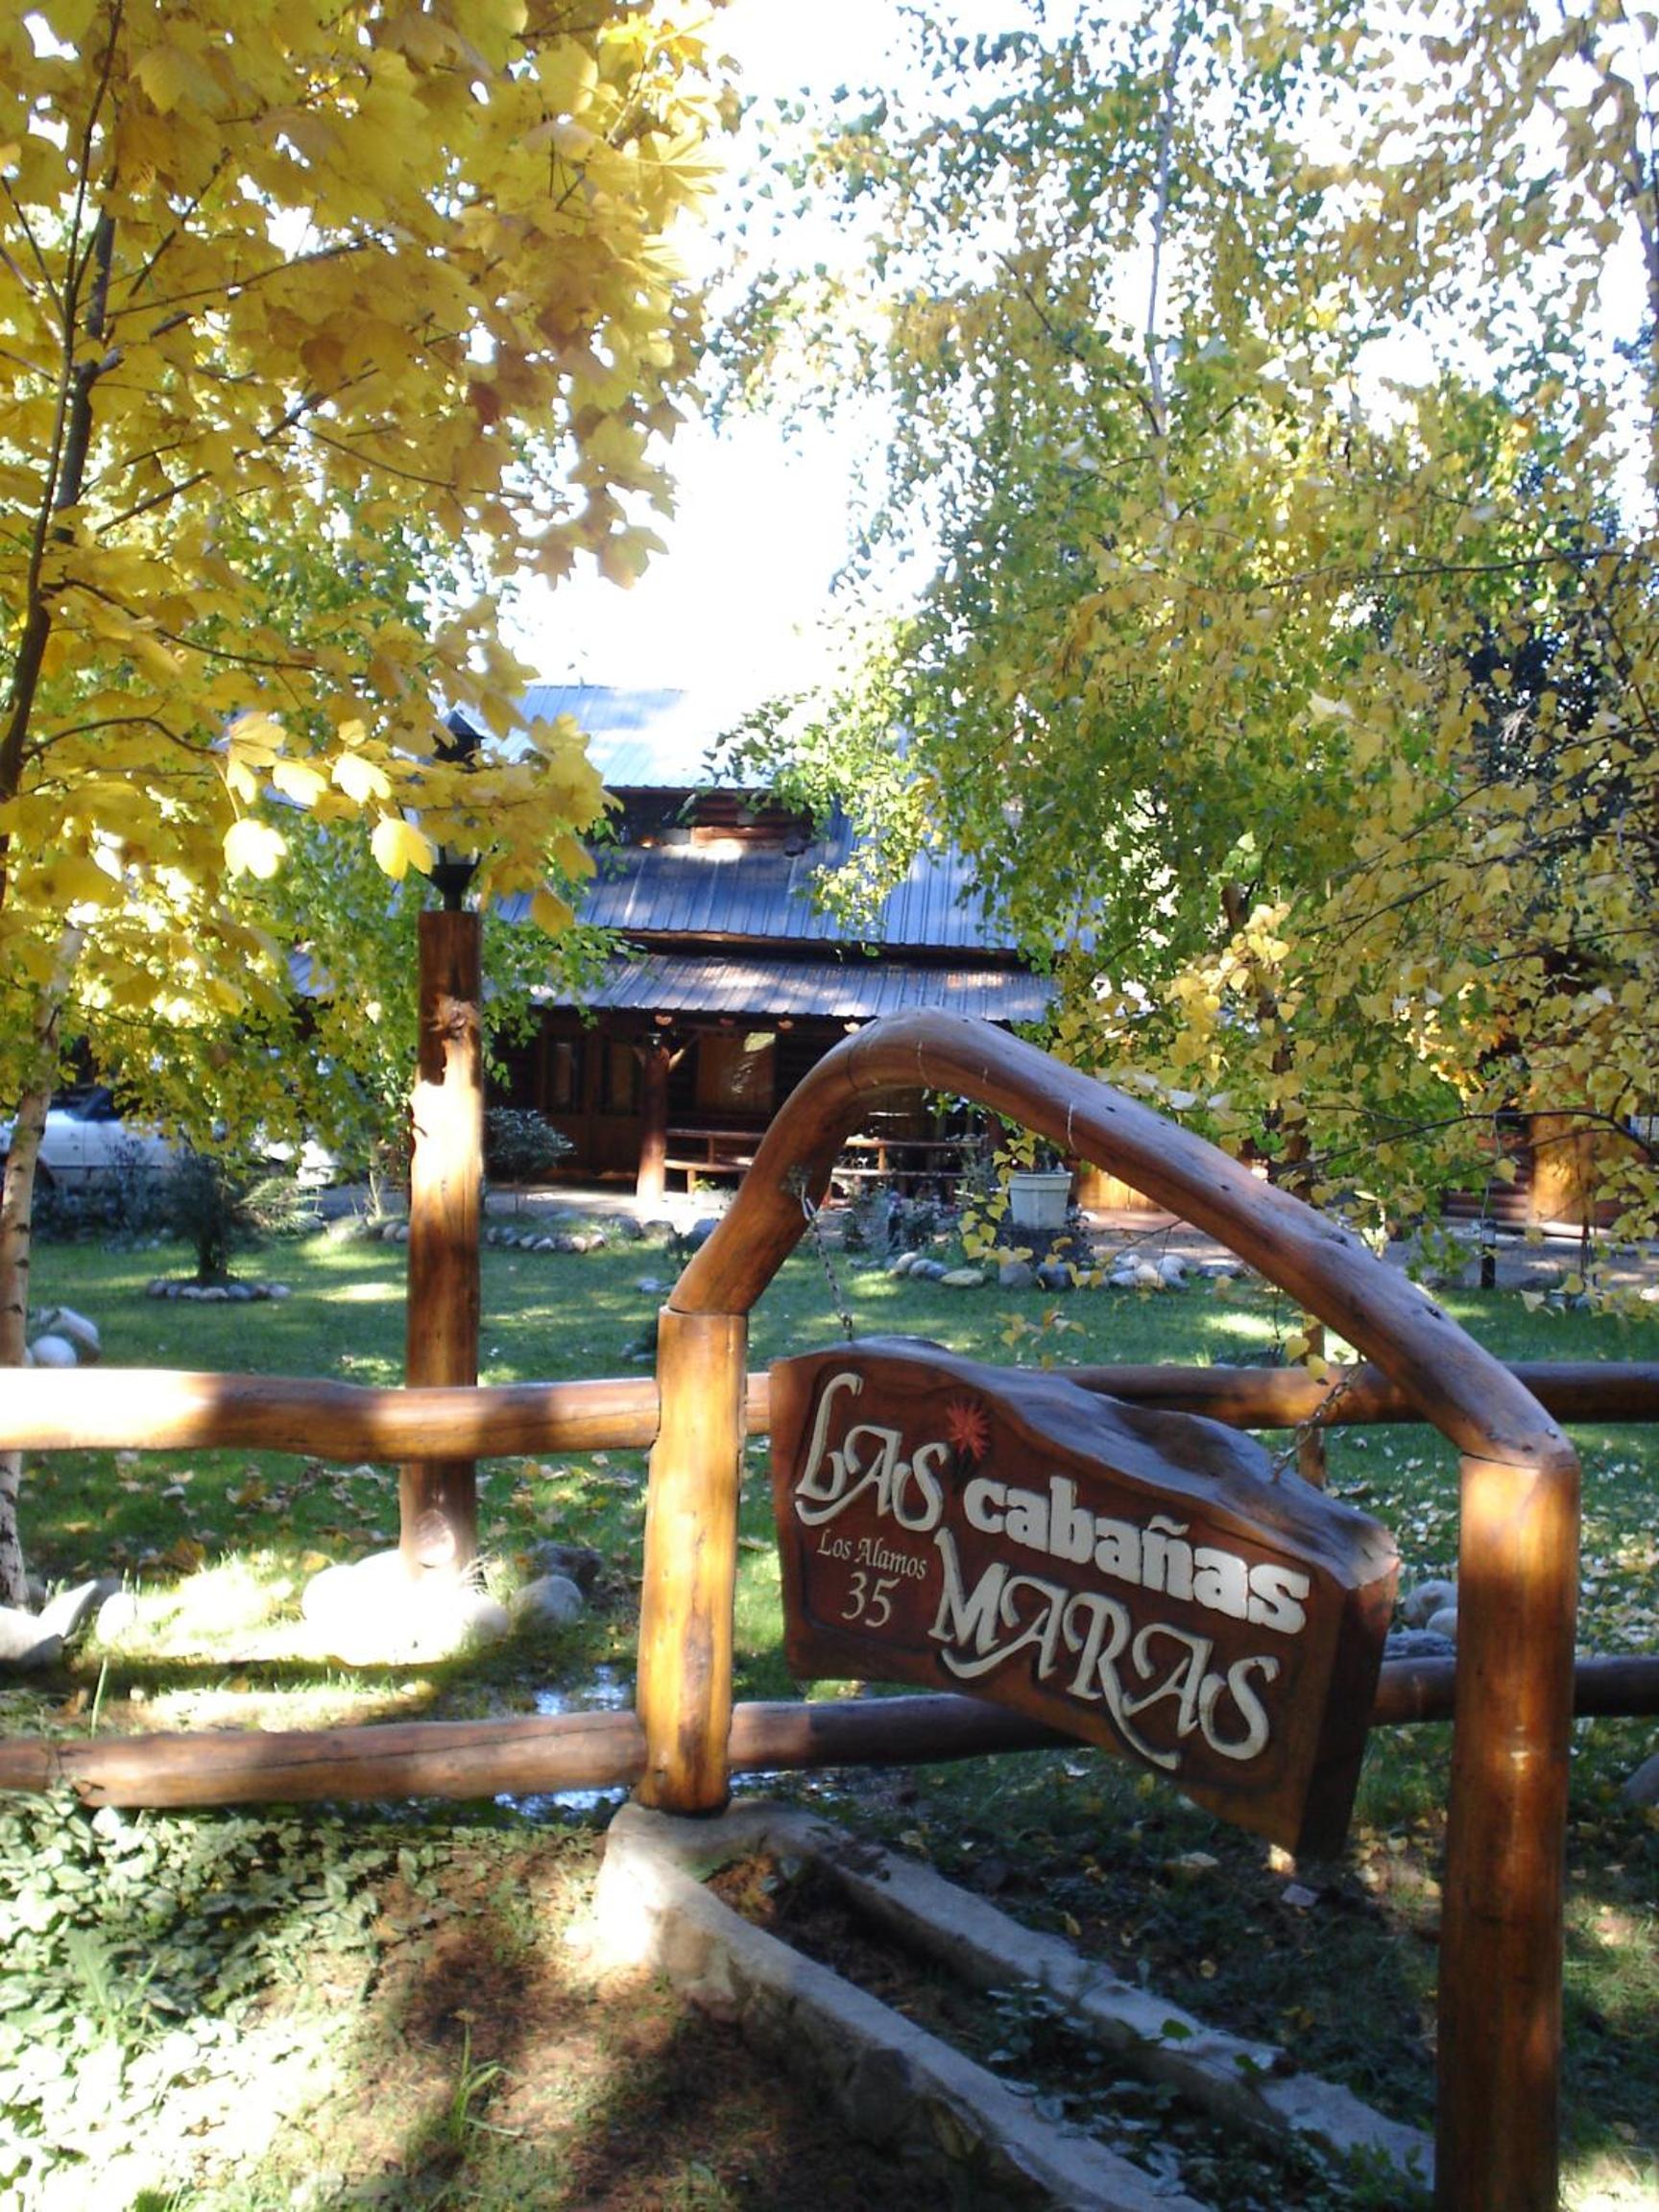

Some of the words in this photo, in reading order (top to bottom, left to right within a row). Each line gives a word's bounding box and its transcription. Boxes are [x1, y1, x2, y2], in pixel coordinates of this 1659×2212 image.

[817, 1528, 853, 1559] Los
[854, 1536, 927, 1580] Alamos
[841, 1571, 901, 1628] 35
[963, 1476, 1310, 1634] cabañas
[927, 1527, 1280, 1770] MARAS
